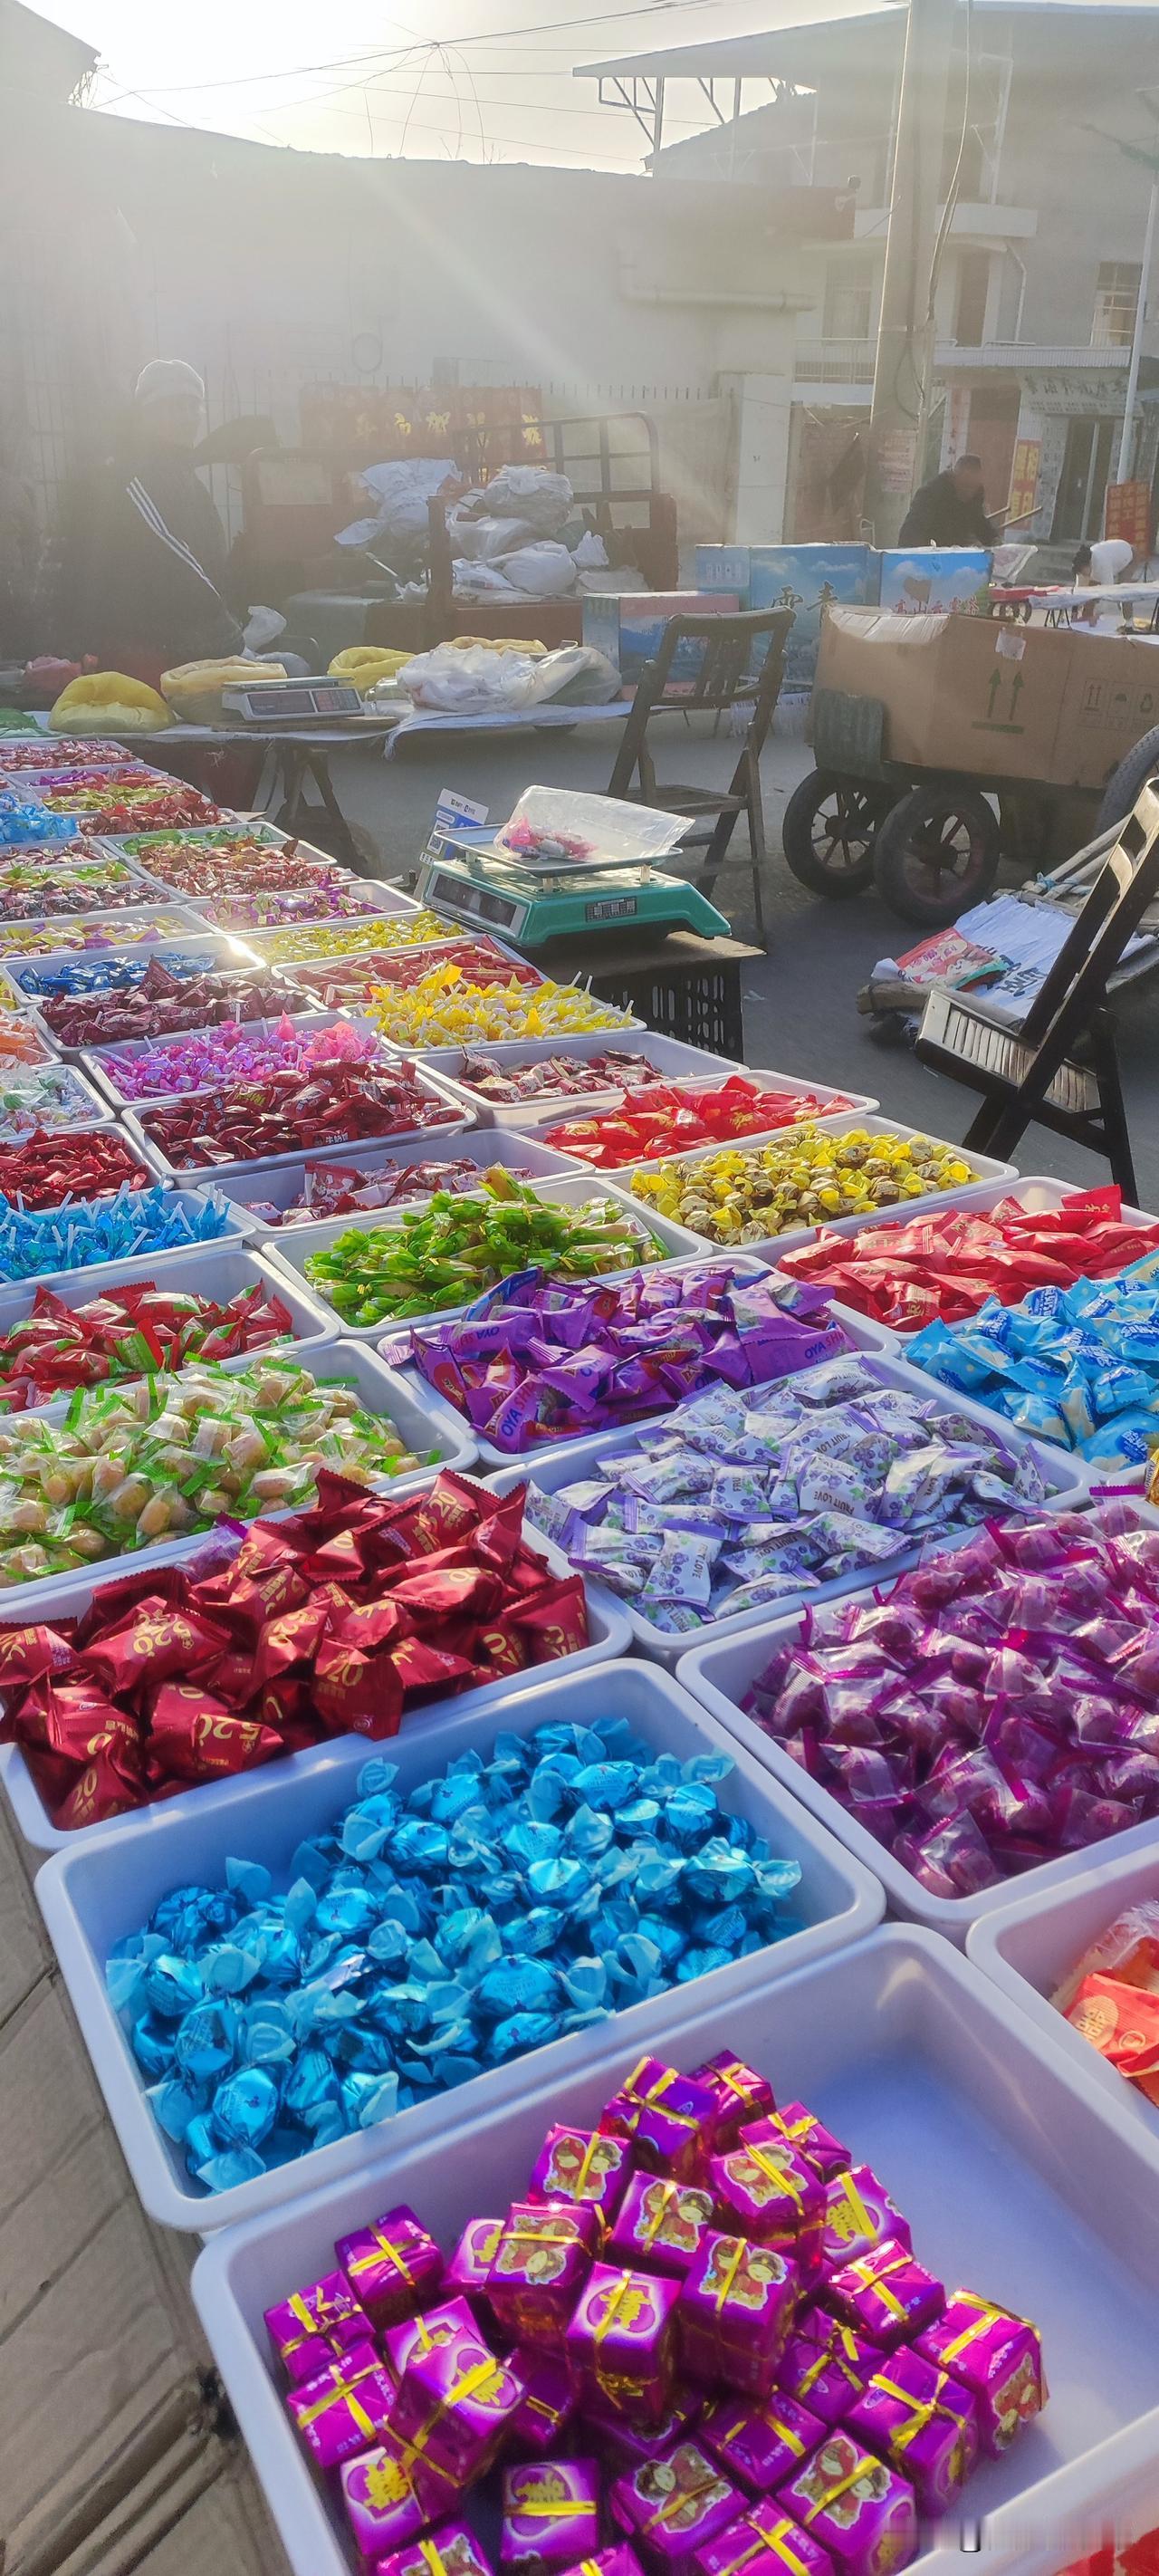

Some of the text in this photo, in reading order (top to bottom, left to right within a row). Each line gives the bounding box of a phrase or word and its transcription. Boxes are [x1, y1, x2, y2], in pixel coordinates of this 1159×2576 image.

[804, 1342, 827, 1359] OYA
[501, 1408, 523, 1438] OYA
[733, 1477, 742, 1492] FRU
[813, 1491, 855, 1514] FRUIT LOVE
[754, 1545, 774, 1561] LOVE
[692, 1559, 706, 1580] LOVE
[132, 1620, 190, 1656] 520
[72, 1768, 98, 1809] 20
